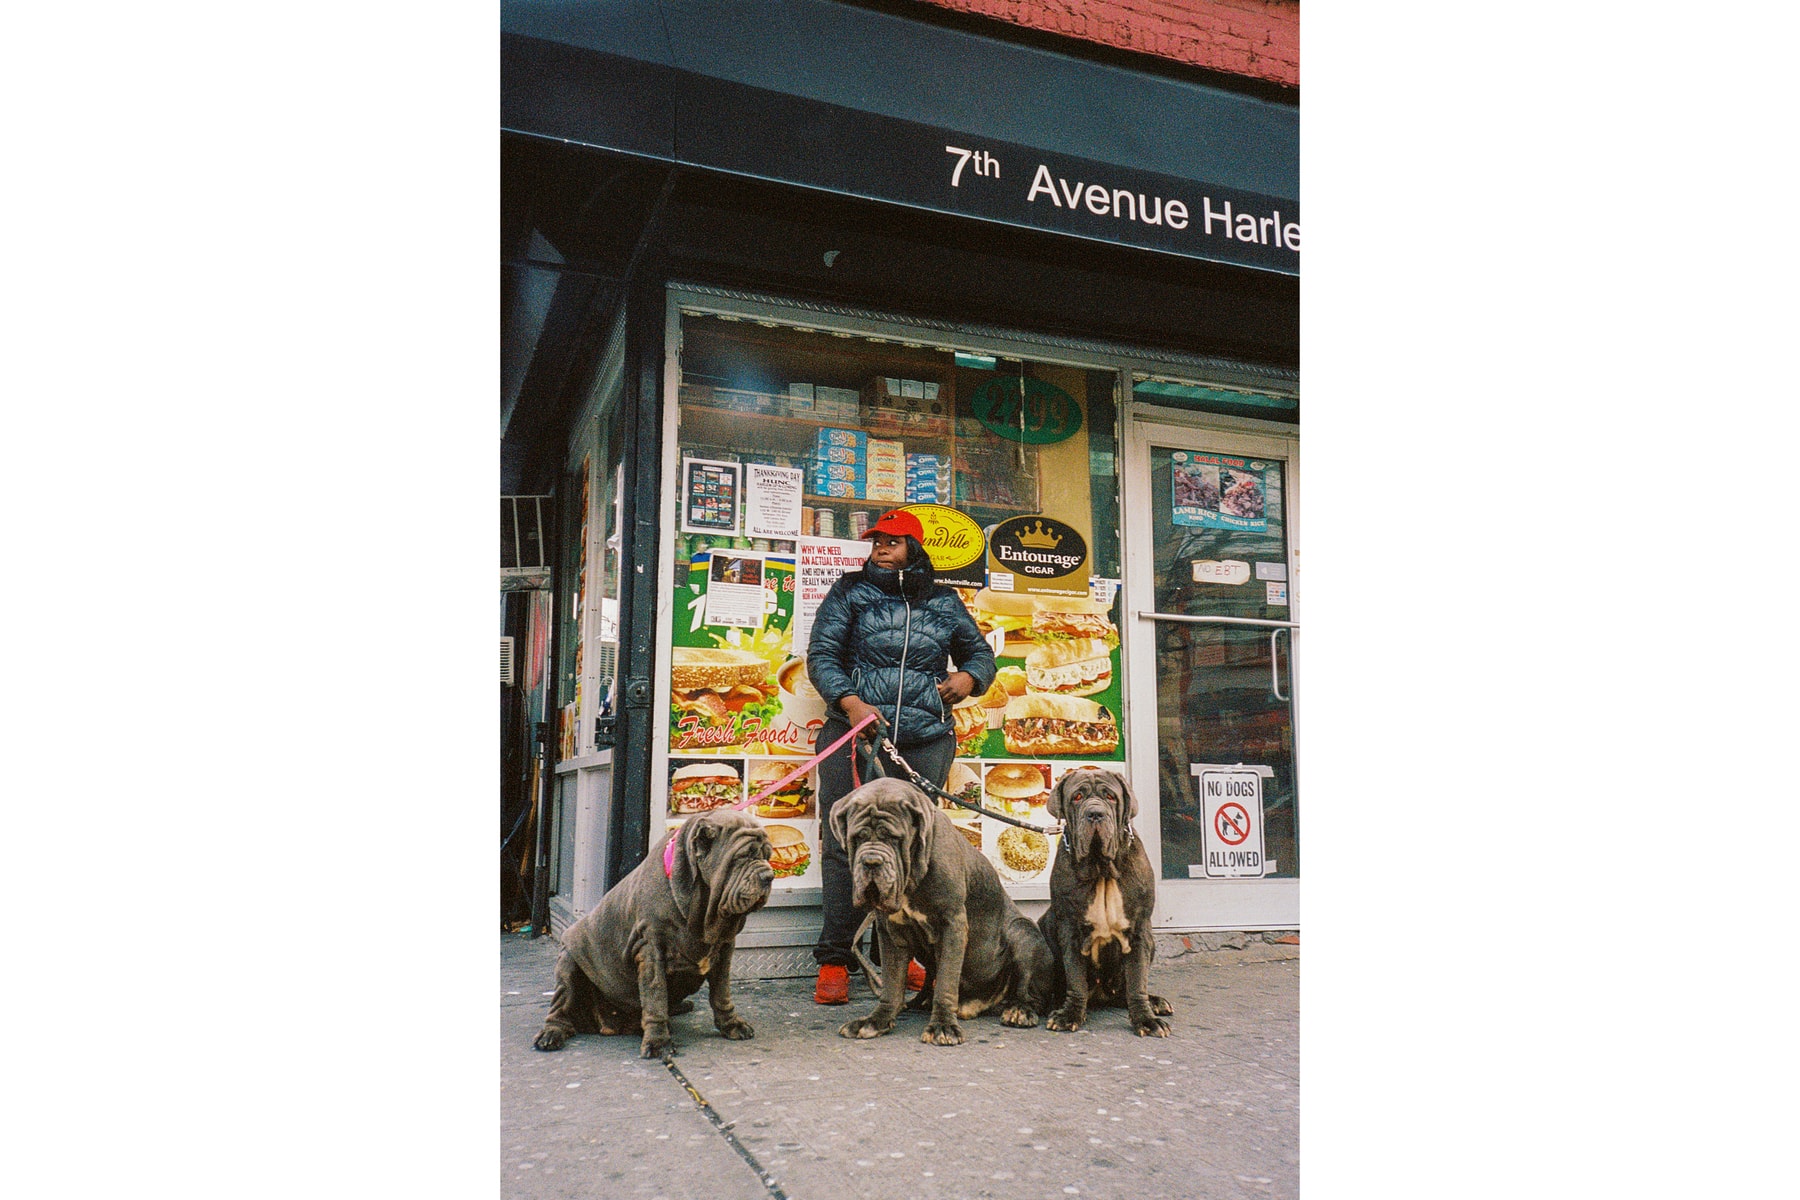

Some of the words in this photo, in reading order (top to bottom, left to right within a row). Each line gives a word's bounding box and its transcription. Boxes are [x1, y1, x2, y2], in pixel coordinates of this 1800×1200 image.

[946, 145, 1000, 187] 7th
[1027, 164, 1189, 229] Avenue
[986, 384, 1069, 434] 2299
[1193, 455, 1220, 464] HALAL
[1221, 458, 1245, 467] FOOD
[754, 468, 790, 479] THANKSGIVING
[790, 472, 801, 482] DAY
[1173, 507, 1196, 515] LAMB
[753, 526, 762, 534] ALL
[774, 529, 799, 537] WELCOME
[801, 545, 815, 555] WHY
[816, 546, 826, 555] WE
[828, 546, 842, 556] NEED
[1000, 545, 1080, 568] Entourage
[801, 556, 811, 566] AN
[811, 556, 833, 566] ACTUAL
[802, 568, 812, 576] AND
[813, 568, 825, 576] HOW
[827, 568, 835, 577] WE
[1025, 565, 1054, 575] CIGAR
[1215, 564, 1241, 576] EBT
[802, 577, 820, 586] REALLY
[678, 716, 736, 748] Fresh
[742, 717, 799, 749] Foods
[1207, 781, 1222, 797] NO
[1226, 781, 1255, 797] DOGS
[1209, 851, 1259, 867] ALLOWED
